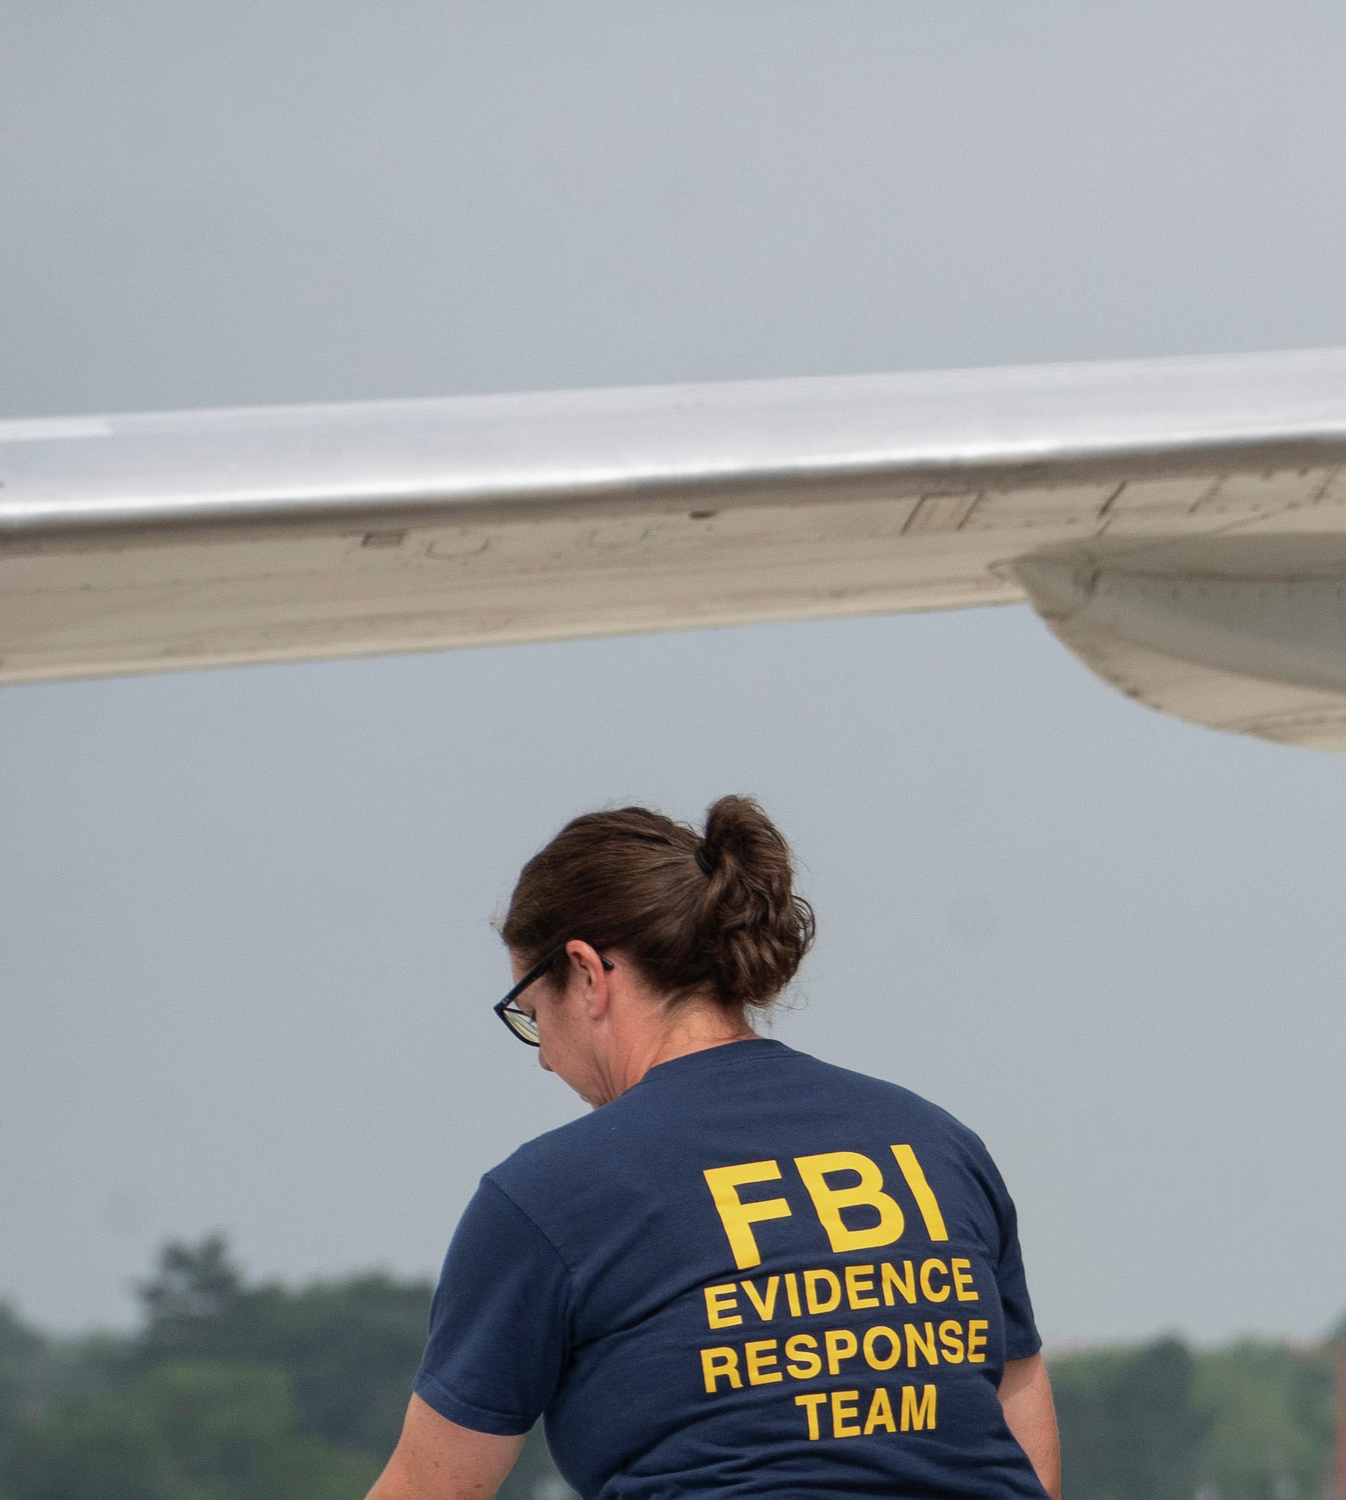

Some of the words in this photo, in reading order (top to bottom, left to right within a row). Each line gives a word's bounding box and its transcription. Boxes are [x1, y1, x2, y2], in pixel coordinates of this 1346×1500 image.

[703, 1144, 948, 1270] FBI
[703, 1258, 979, 1330] EVIDENCE
[699, 1320, 988, 1394] RESPONSE
[795, 1384, 936, 1441] TEAM
